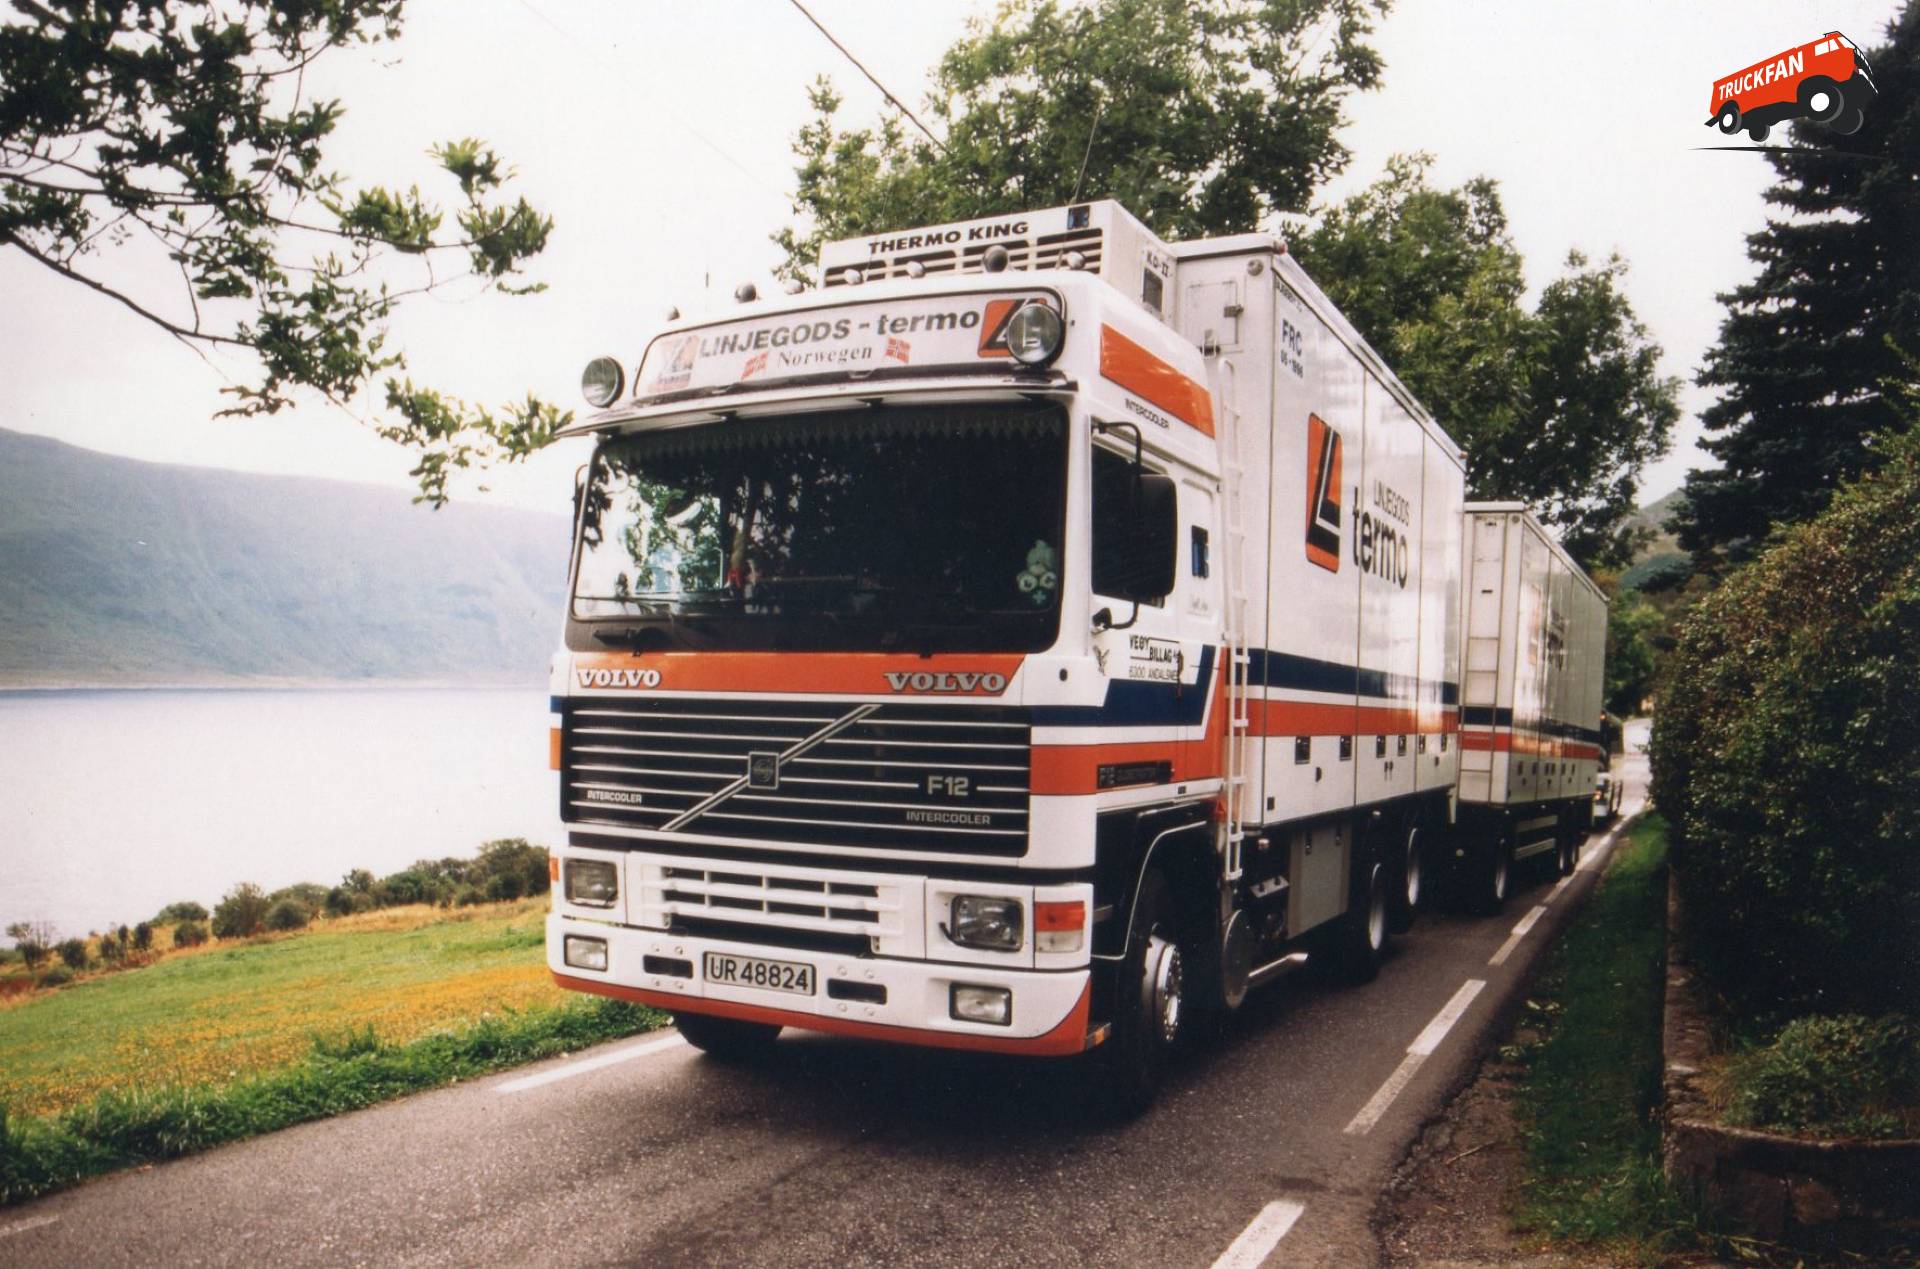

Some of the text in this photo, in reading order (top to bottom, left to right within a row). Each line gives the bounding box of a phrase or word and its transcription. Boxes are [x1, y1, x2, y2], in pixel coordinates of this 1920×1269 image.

[868, 221, 1029, 254] THERMO KING
[700, 318, 851, 358] LINJEGODS
[876, 310, 980, 336] termo
[1282, 318, 1302, 357] FRC
[778, 344, 873, 368] Norwegen
[1125, 398, 1169, 430] INTERCOOLER
[1353, 486, 1408, 589] termo
[577, 669, 661, 688] VOLVO
[883, 672, 1006, 692] VOLVO
[587, 790, 642, 804] INTERCOOLER
[927, 775, 969, 796] F12
[905, 810, 991, 825] INTERCOOLER
[711, 956, 809, 991] UR 48824
